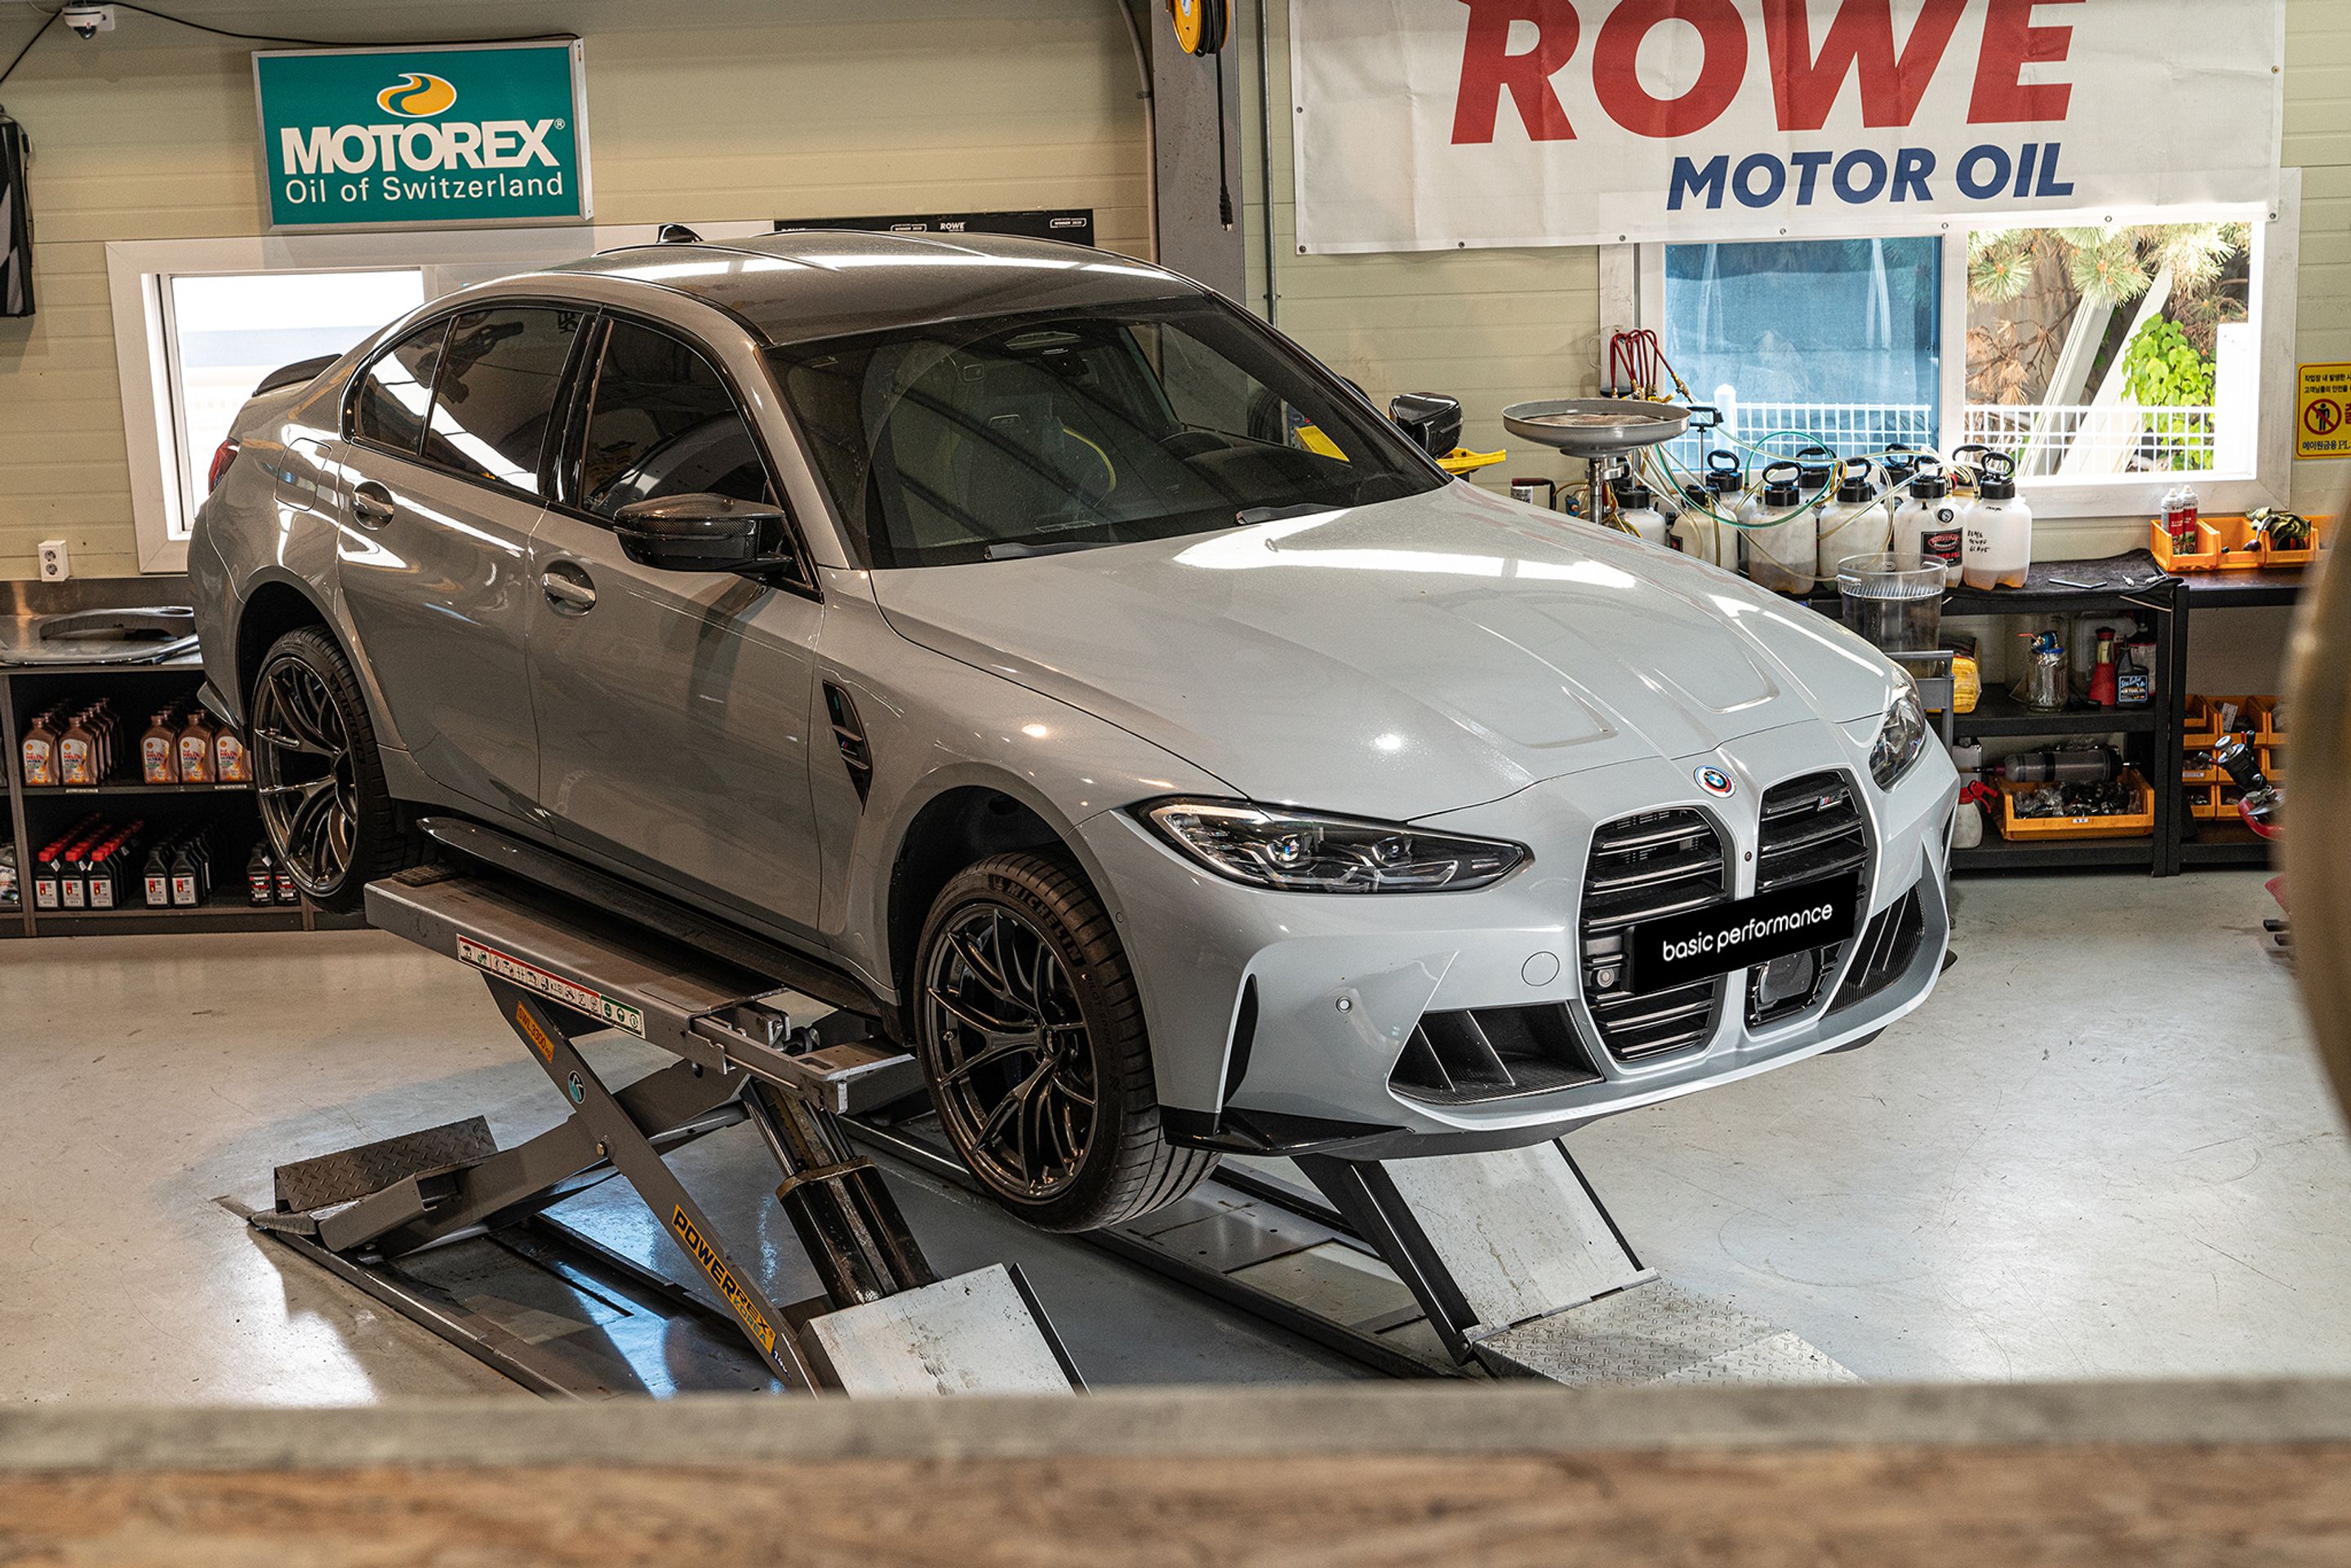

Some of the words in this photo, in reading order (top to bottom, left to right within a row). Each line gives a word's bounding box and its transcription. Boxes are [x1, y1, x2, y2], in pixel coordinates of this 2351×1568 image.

[1451, 0, 2087, 144] ROWE
[286, 180, 327, 203] Oil
[340, 177, 369, 202] of
[383, 171, 563, 201] Switzerland
[1666, 147, 1936, 211] MOTOR
[1955, 142, 2074, 200] OIL
[940, 222, 965, 230] ROWE
[1007, 882, 1083, 962] MICHELIN
[1662, 931, 1713, 962] basic
[1717, 904, 1833, 953] performance
[733, 1299, 767, 1345] KOREA
